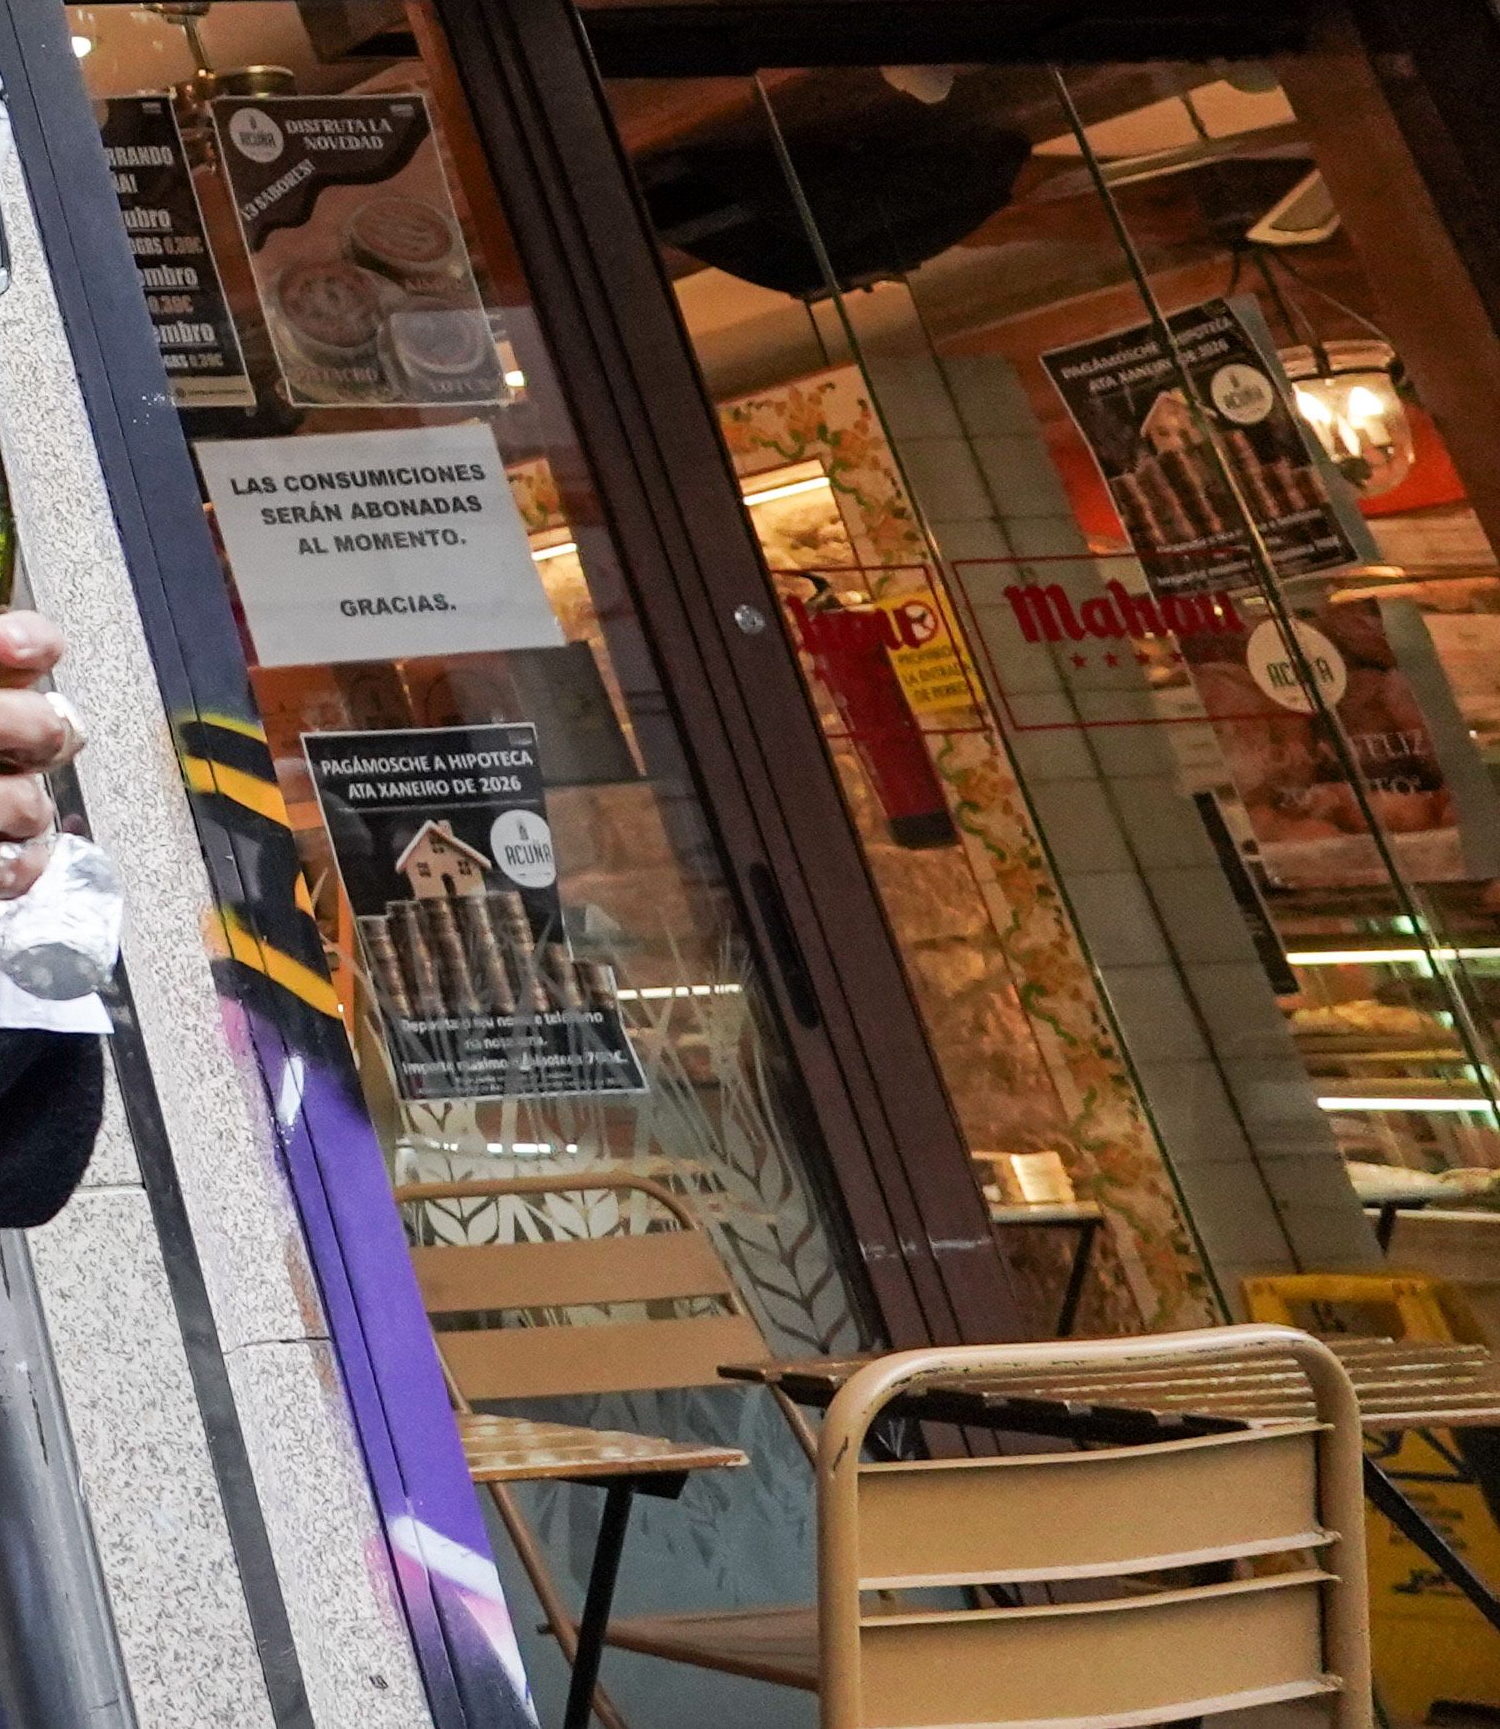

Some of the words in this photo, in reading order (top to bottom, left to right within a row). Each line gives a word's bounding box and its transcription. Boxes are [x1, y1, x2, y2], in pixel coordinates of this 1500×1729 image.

[284, 118, 368, 134] DISFRUTA
[369, 118, 393, 133] LA
[303, 135, 385, 151] NOVEDAD
[230, 474, 277, 496] LAS
[284, 464, 486, 493] CONSUMICIONES
[260, 501, 342, 526] SERÁN
[350, 495, 483, 520] ABONADAS
[298, 535, 329, 556] AL
[334, 528, 467, 554] MOMENTO.
[339, 593, 457, 618] GRACIAS.
[1003, 577, 1247, 643] Mahou
[320, 755, 431, 776] PAGÁMOSCHE
[433, 754, 446, 770] A
[448, 750, 534, 770] HIPOTECA
[348, 783, 377, 800] ATA
[379, 780, 450, 798] XANEIRO
[452, 778, 475, 795] DE
[481, 775, 522, 792] 2026
